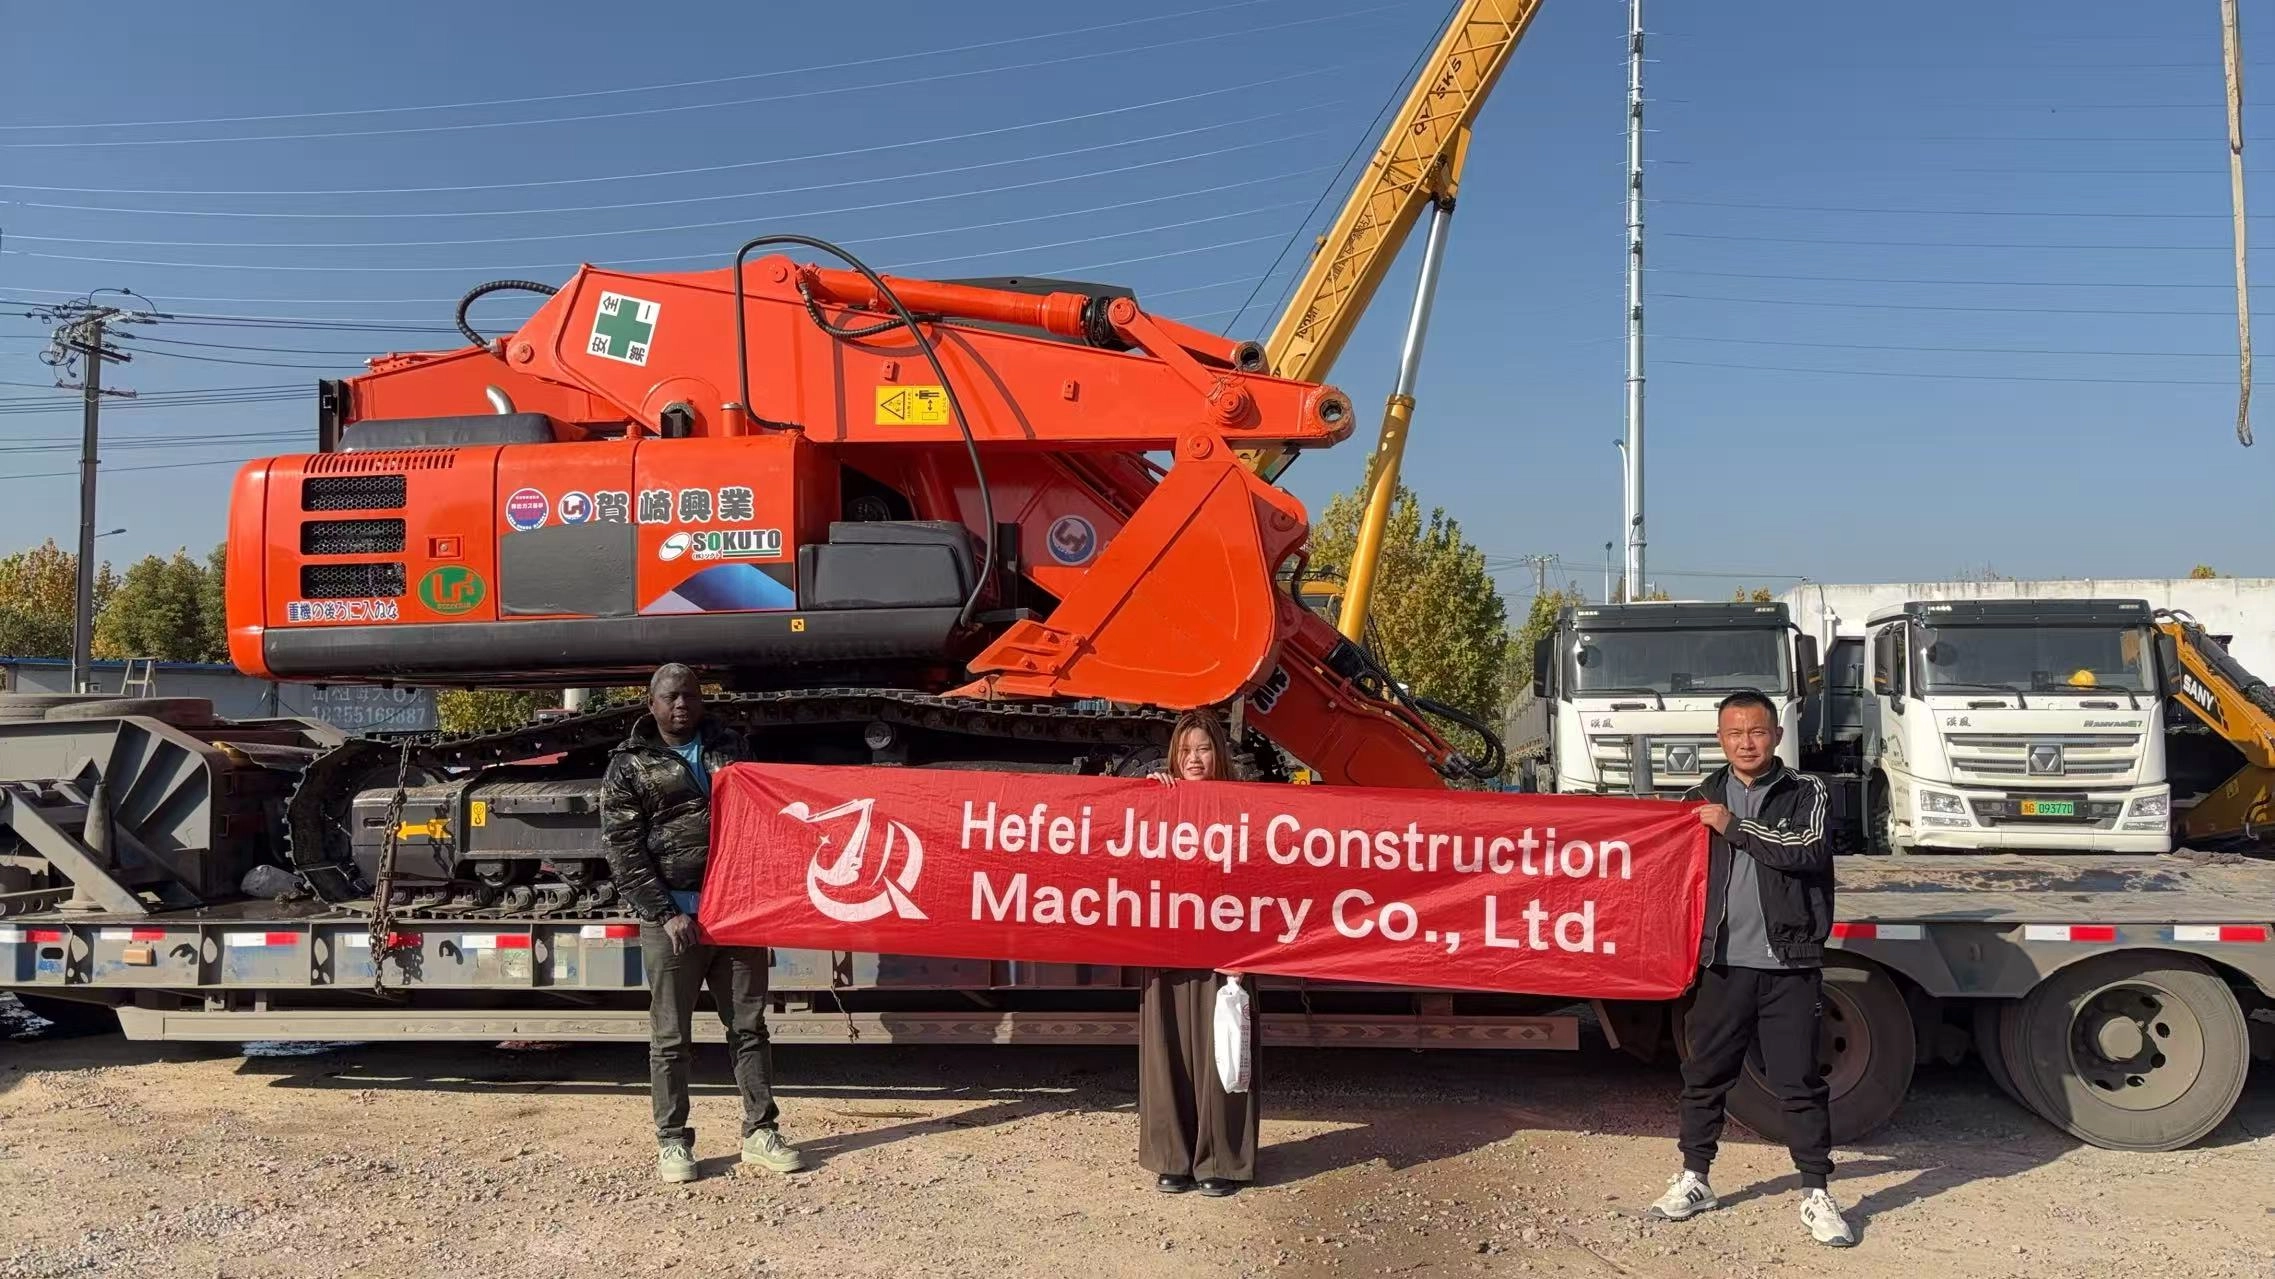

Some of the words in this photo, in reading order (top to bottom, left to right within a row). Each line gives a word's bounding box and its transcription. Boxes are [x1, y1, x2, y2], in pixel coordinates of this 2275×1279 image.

[693, 530, 780, 552] SOKUTO
[2183, 674, 2214, 711] SANY
[961, 801, 1092, 855] Hefei
[1106, 808, 1249, 873] Jueqi
[1266, 814, 1631, 880] Construction
[971, 871, 1313, 944] Machinery
[1332, 889, 1460, 954] Co.,
[1485, 895, 1616, 955] Ltd.
